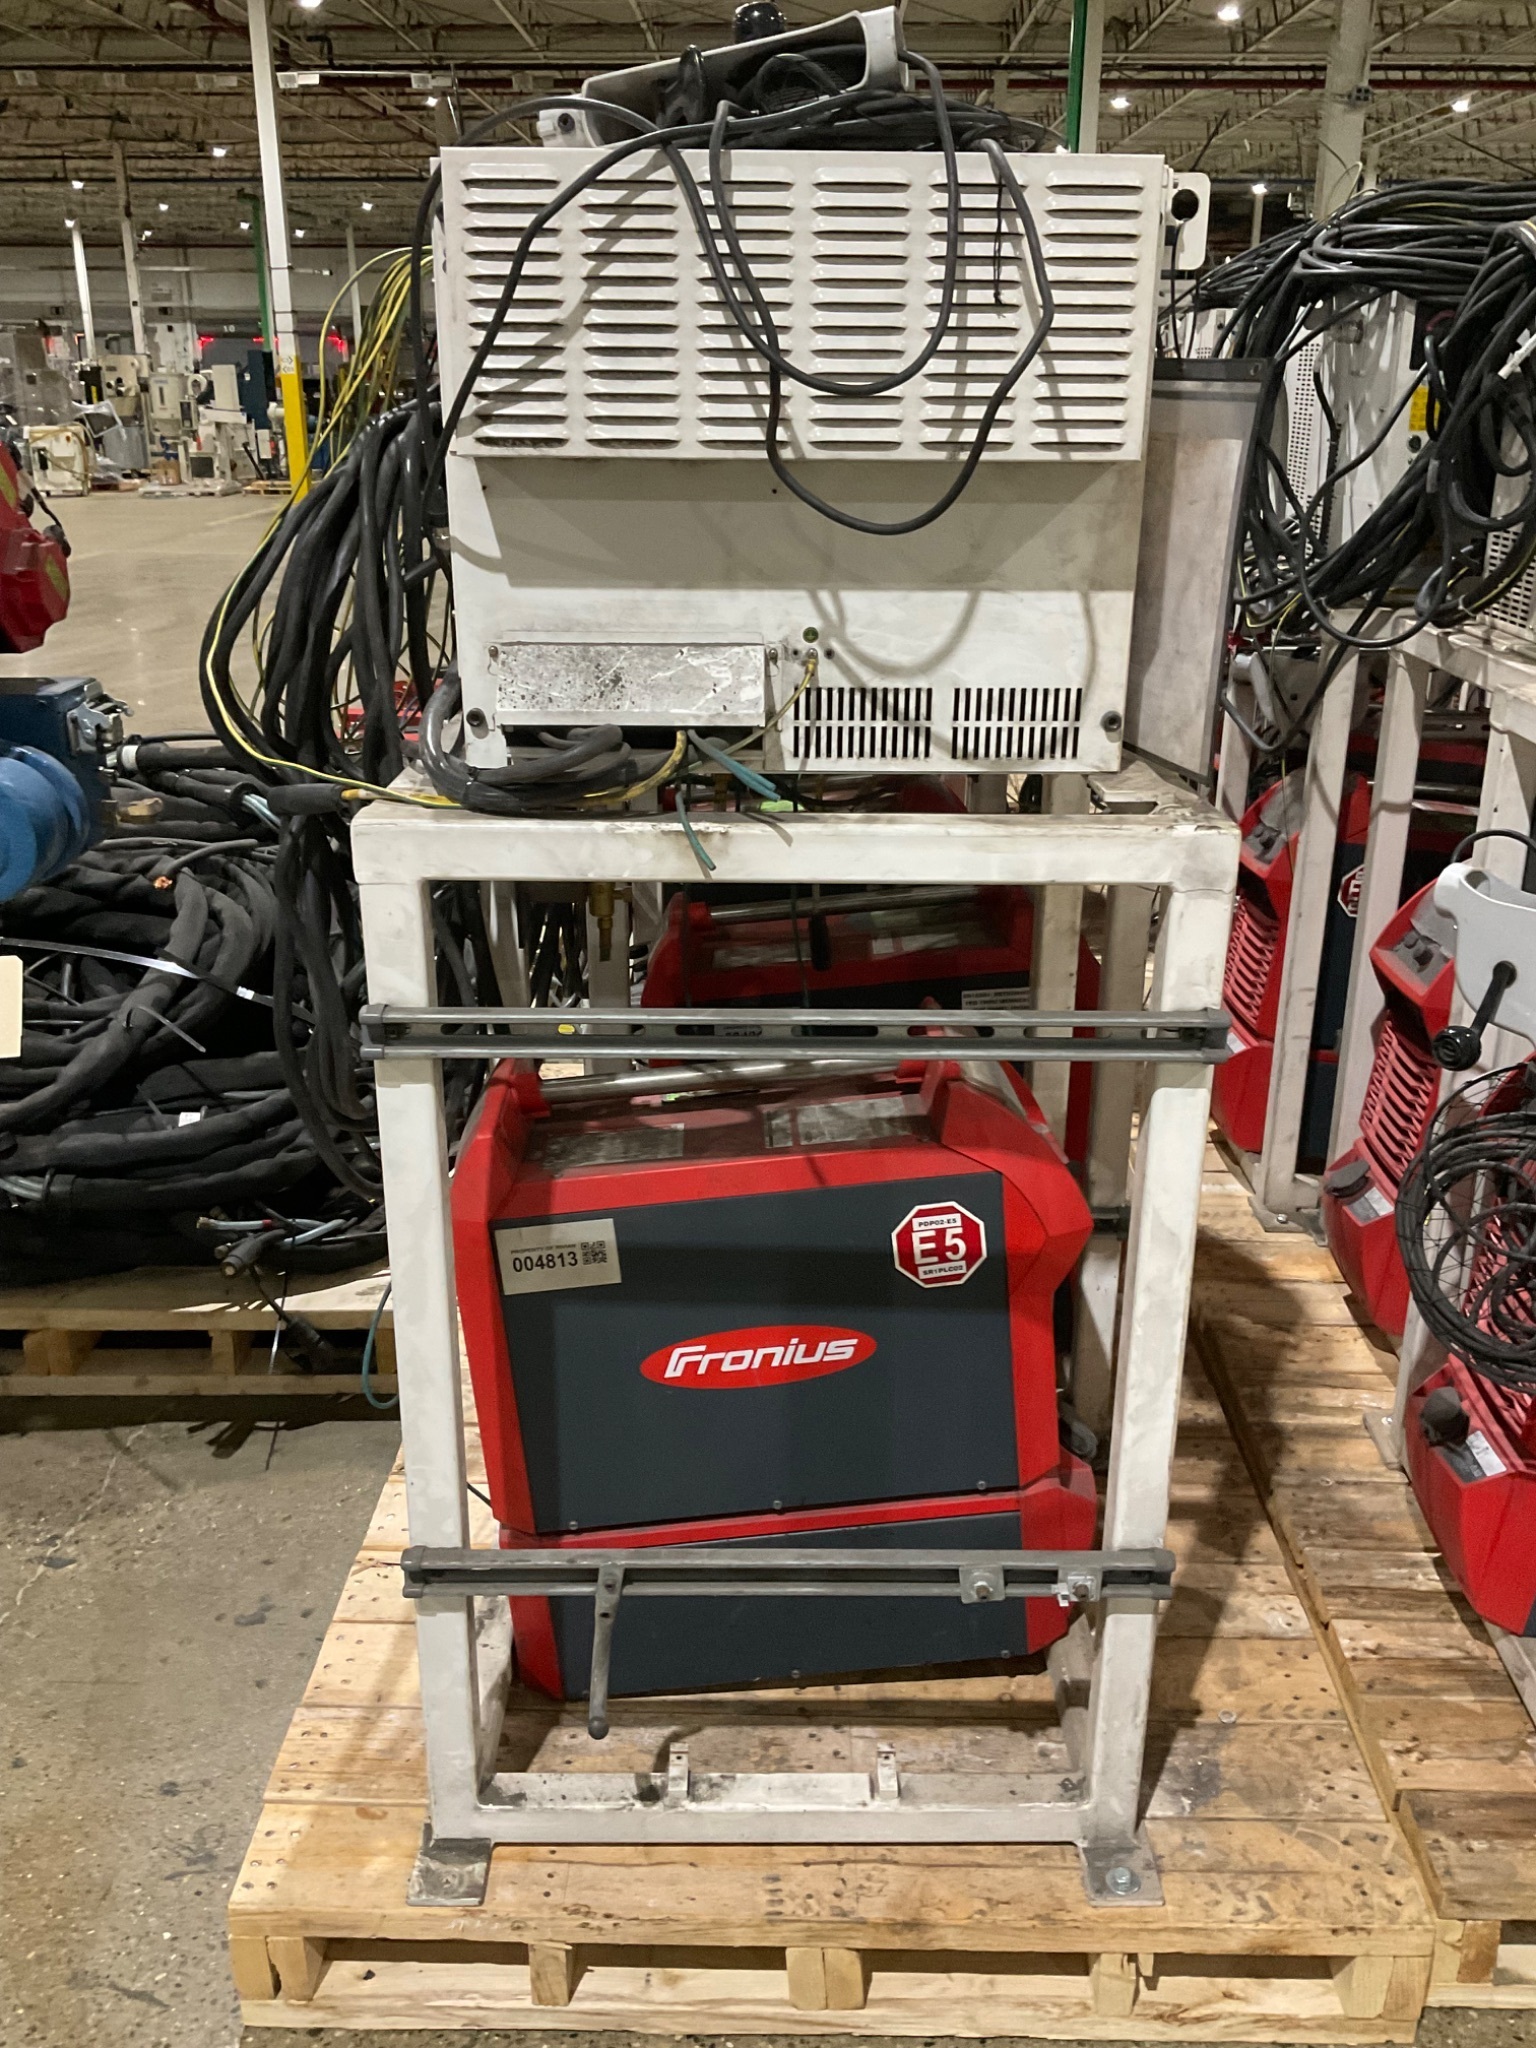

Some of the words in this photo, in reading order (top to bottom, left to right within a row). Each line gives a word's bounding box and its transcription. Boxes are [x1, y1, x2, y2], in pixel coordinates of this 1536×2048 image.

[512, 1250, 579, 1273] 004813
[911, 1226, 967, 1265] E5
[663, 1337, 859, 1379] Fronius
